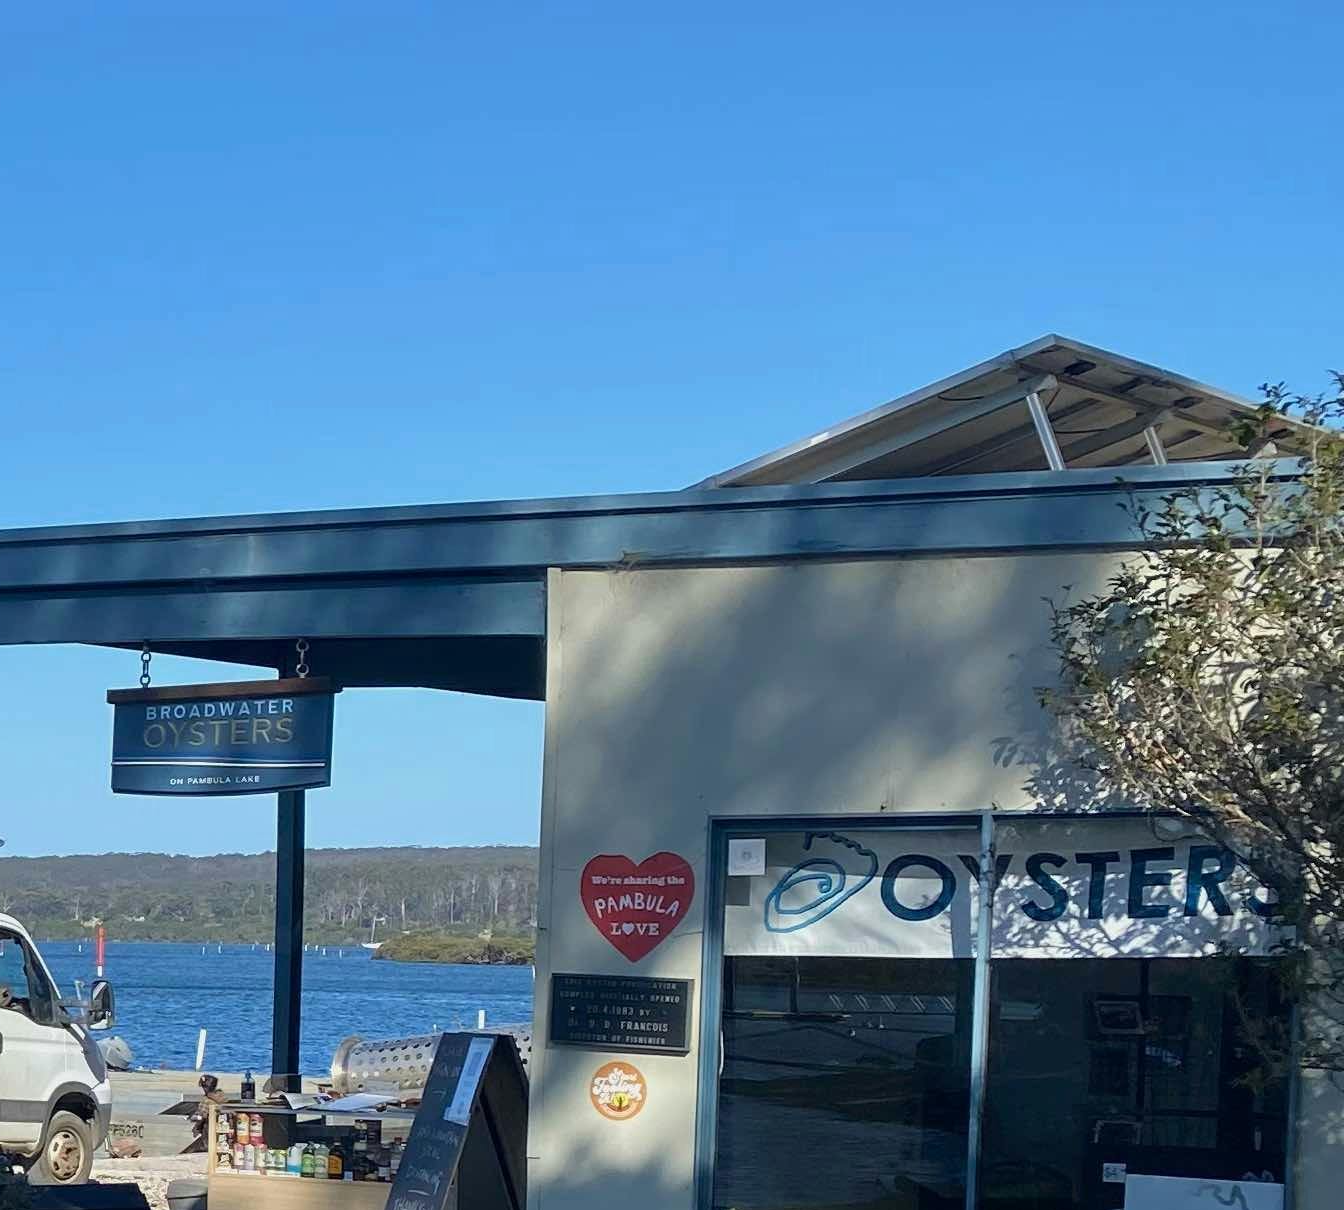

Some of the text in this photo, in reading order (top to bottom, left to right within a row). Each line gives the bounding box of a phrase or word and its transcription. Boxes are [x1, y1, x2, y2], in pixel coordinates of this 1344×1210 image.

[146, 699, 294, 721] BROADWATER
[143, 717, 294, 748] OYSTERS
[170, 775, 261, 785] ON PAMBULA LAKE
[592, 876, 685, 886] We're sharing the
[594, 892, 680, 919] PAMBULA
[620, 1021, 668, 1033] FRANCOIS
